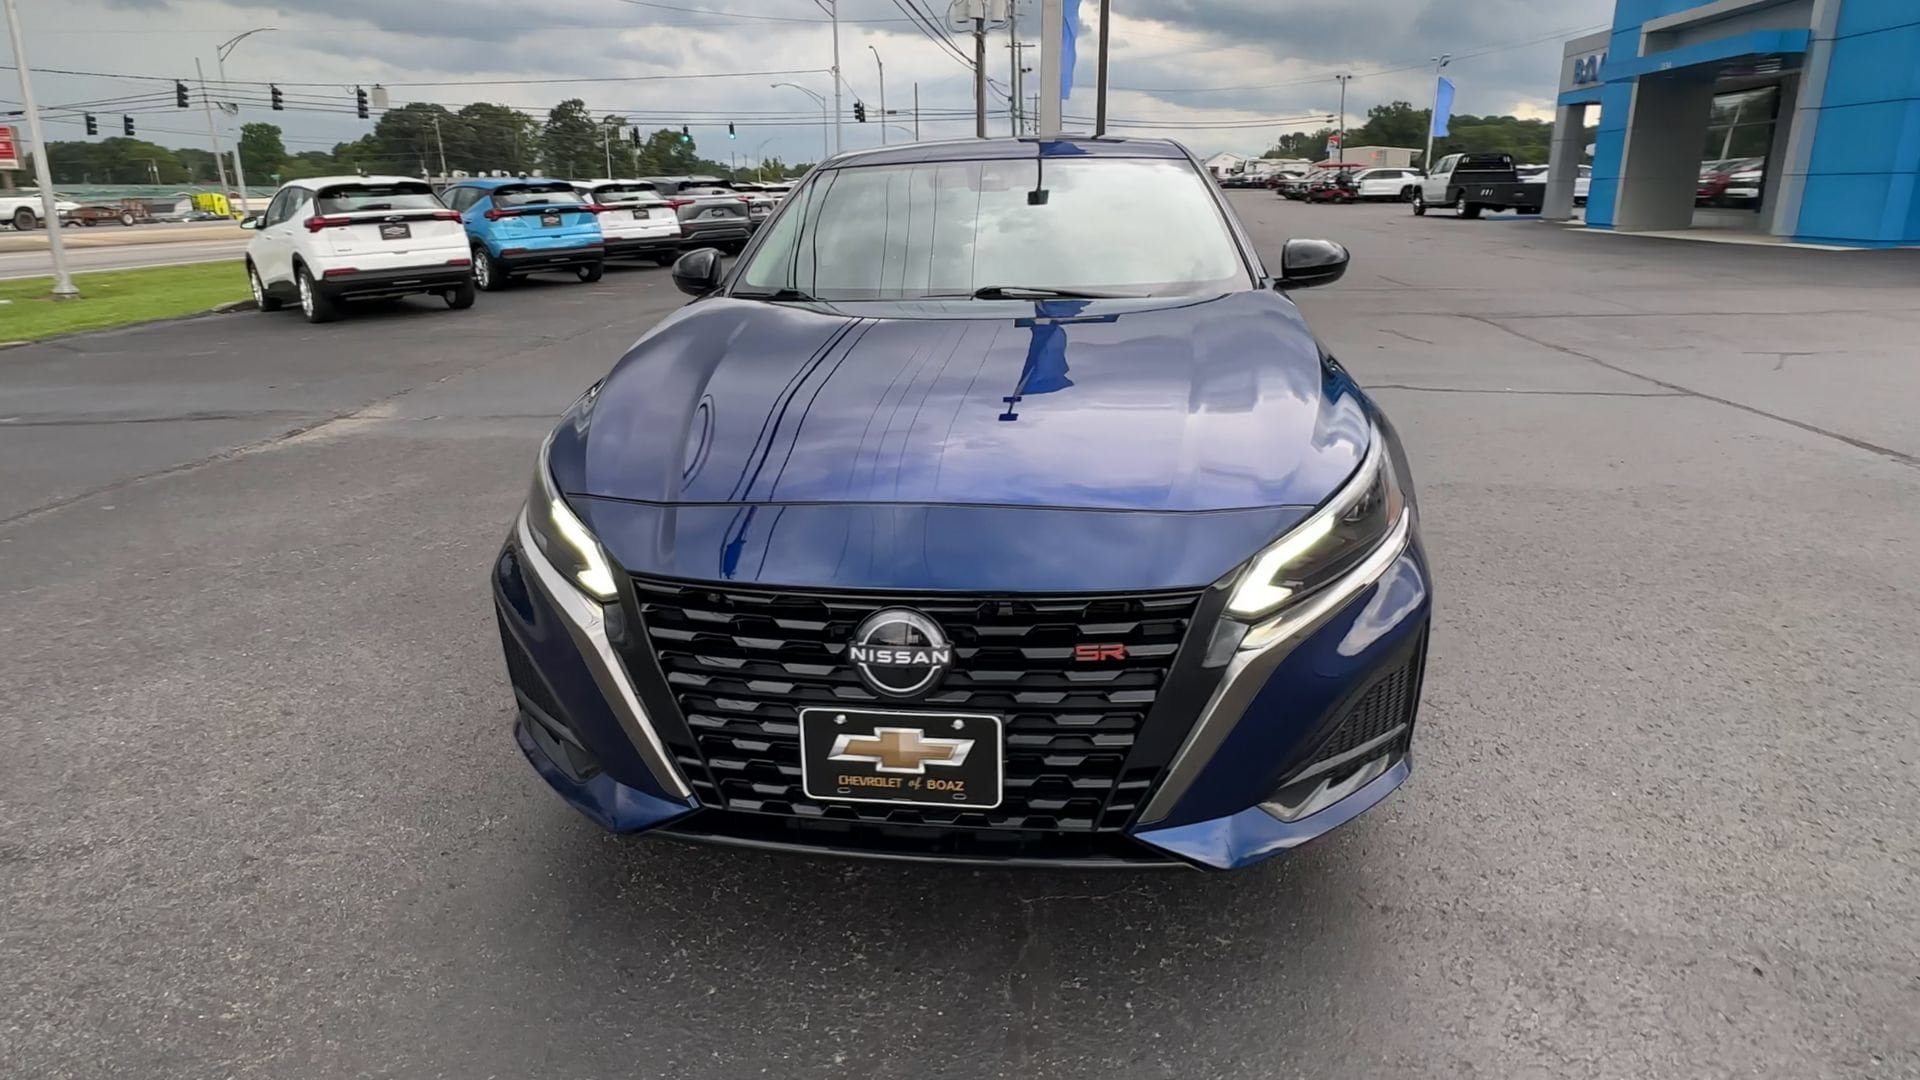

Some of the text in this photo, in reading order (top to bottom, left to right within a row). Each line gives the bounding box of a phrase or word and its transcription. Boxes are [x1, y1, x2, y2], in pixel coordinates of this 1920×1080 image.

[849, 646, 949, 665] NISSAN
[1074, 643, 1126, 662] SR
[837, 774, 965, 791] CHEVROLET of BOAZ
